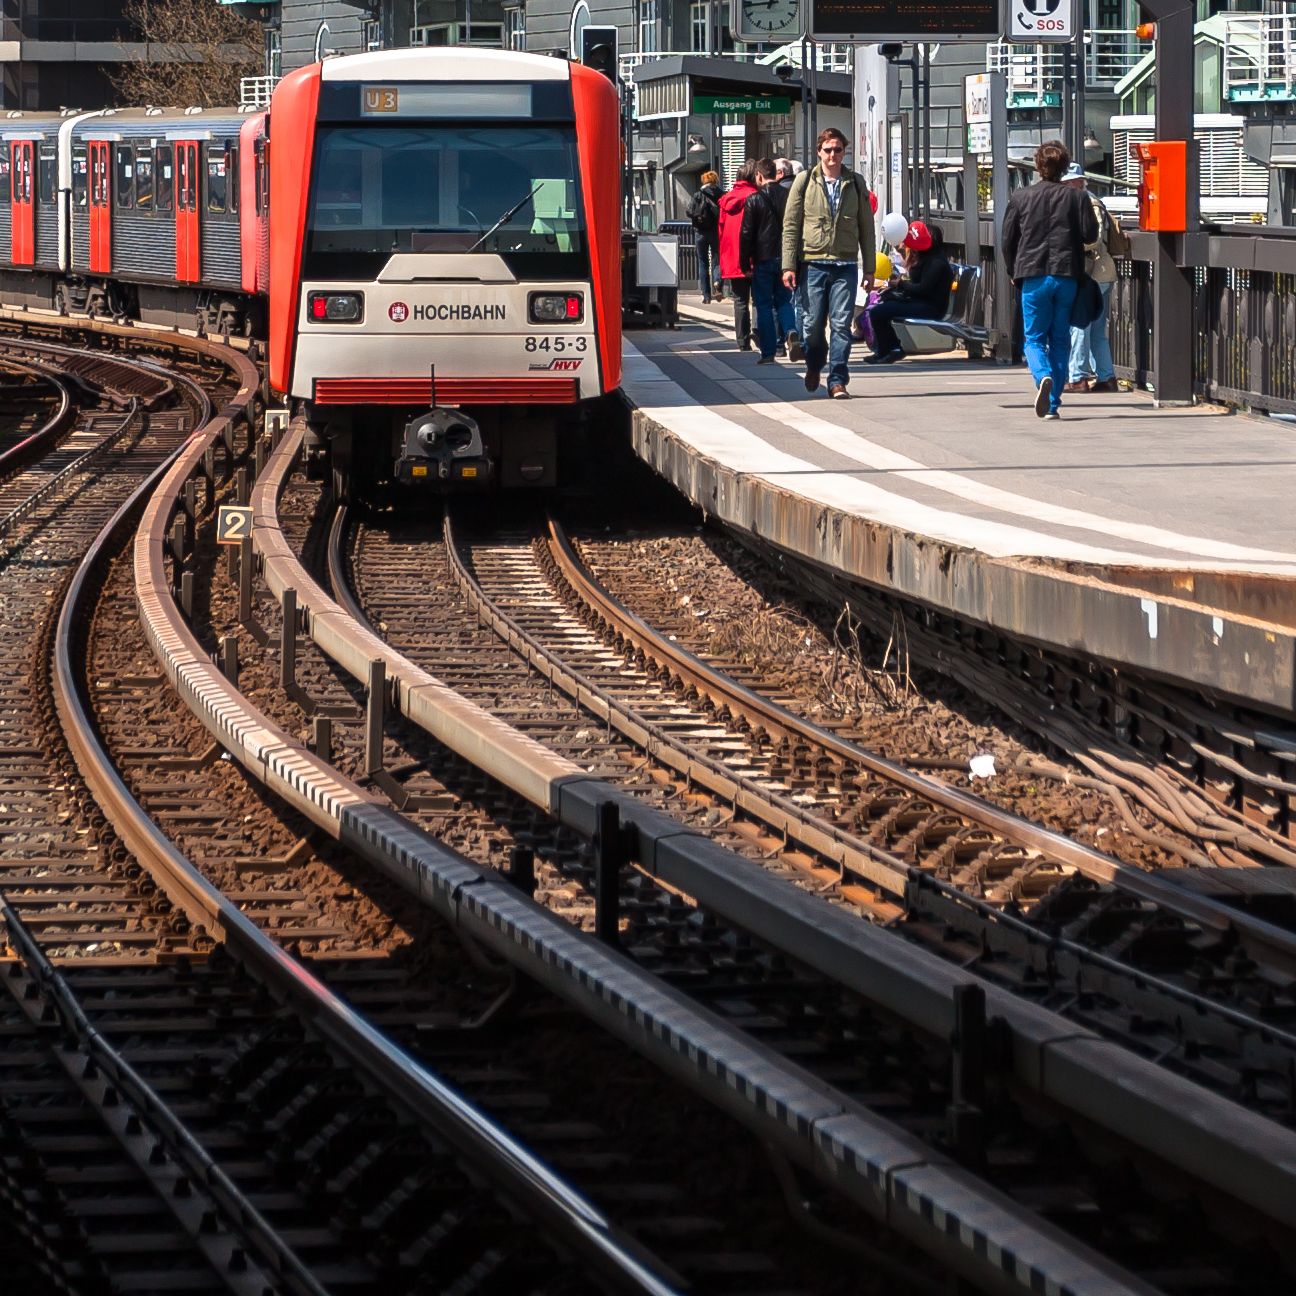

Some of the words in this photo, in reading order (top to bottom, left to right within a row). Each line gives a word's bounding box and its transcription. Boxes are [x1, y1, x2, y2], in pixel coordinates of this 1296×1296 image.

[1036, 19, 1065, 30] SOS
[713, 100, 752, 110] Ausgang
[413, 304, 506, 320] HOCHBAHN
[525, 336, 587, 352] 845-3
[554, 360, 582, 370] HVV
[225, 512, 245, 538] 2
